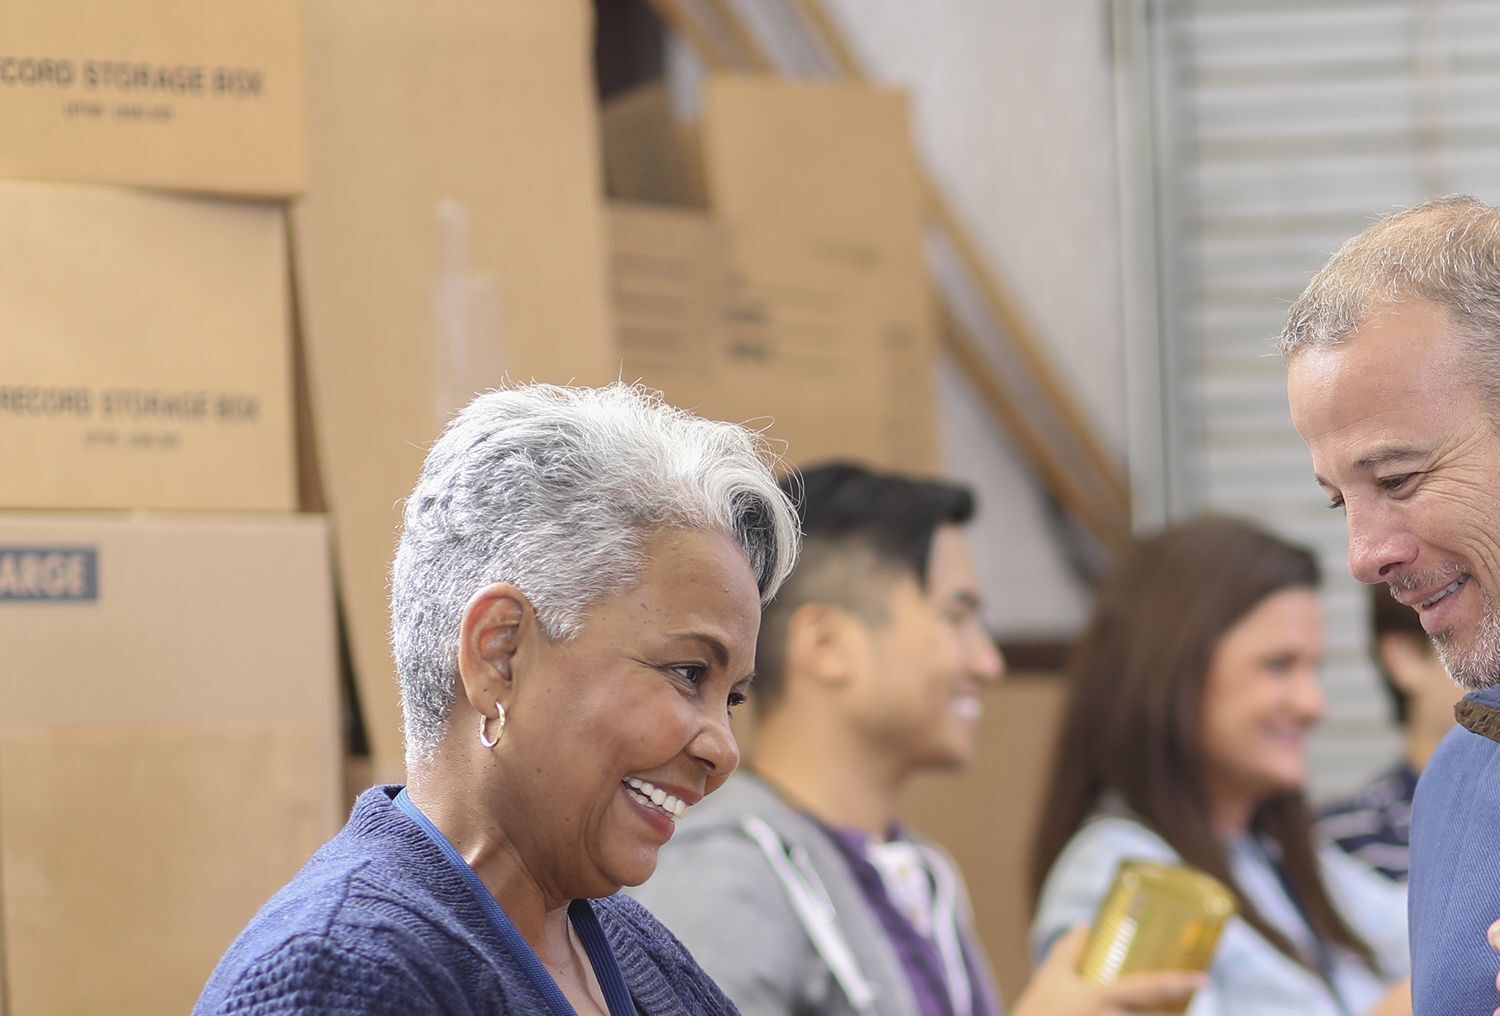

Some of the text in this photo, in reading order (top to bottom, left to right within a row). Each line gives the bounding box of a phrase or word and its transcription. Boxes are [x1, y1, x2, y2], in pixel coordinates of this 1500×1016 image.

[83, 61, 204, 94] STORAGE
[213, 68, 262, 97] BOX
[102, 388, 207, 423] STORAGE
[216, 394, 260, 427] BOX
